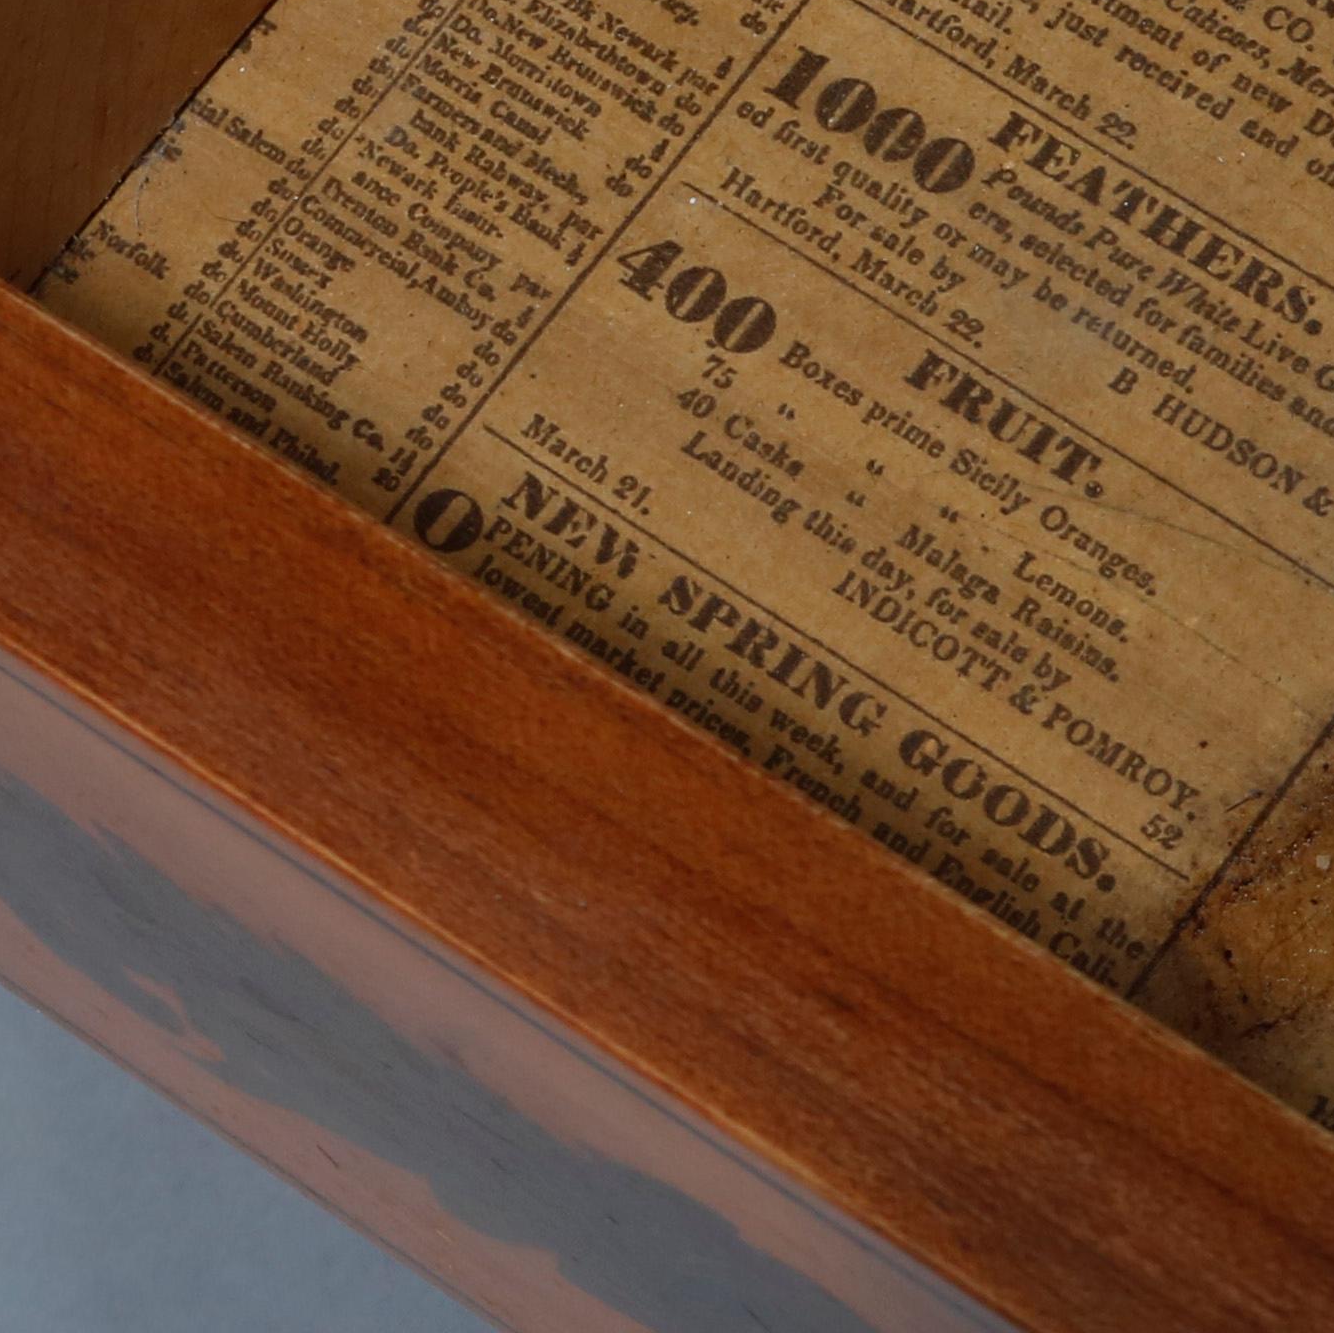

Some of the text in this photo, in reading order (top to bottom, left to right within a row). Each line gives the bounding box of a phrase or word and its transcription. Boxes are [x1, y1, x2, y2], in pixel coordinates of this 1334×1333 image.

[762, 44, 975, 194] 1000
[615, 239, 777, 354] 400
[986, 109, 1323, 336] FEATHERS.
[902, 347, 1105, 505] FRUIT.
[500, 470, 1116, 893] NEW SPRING GOODS.
